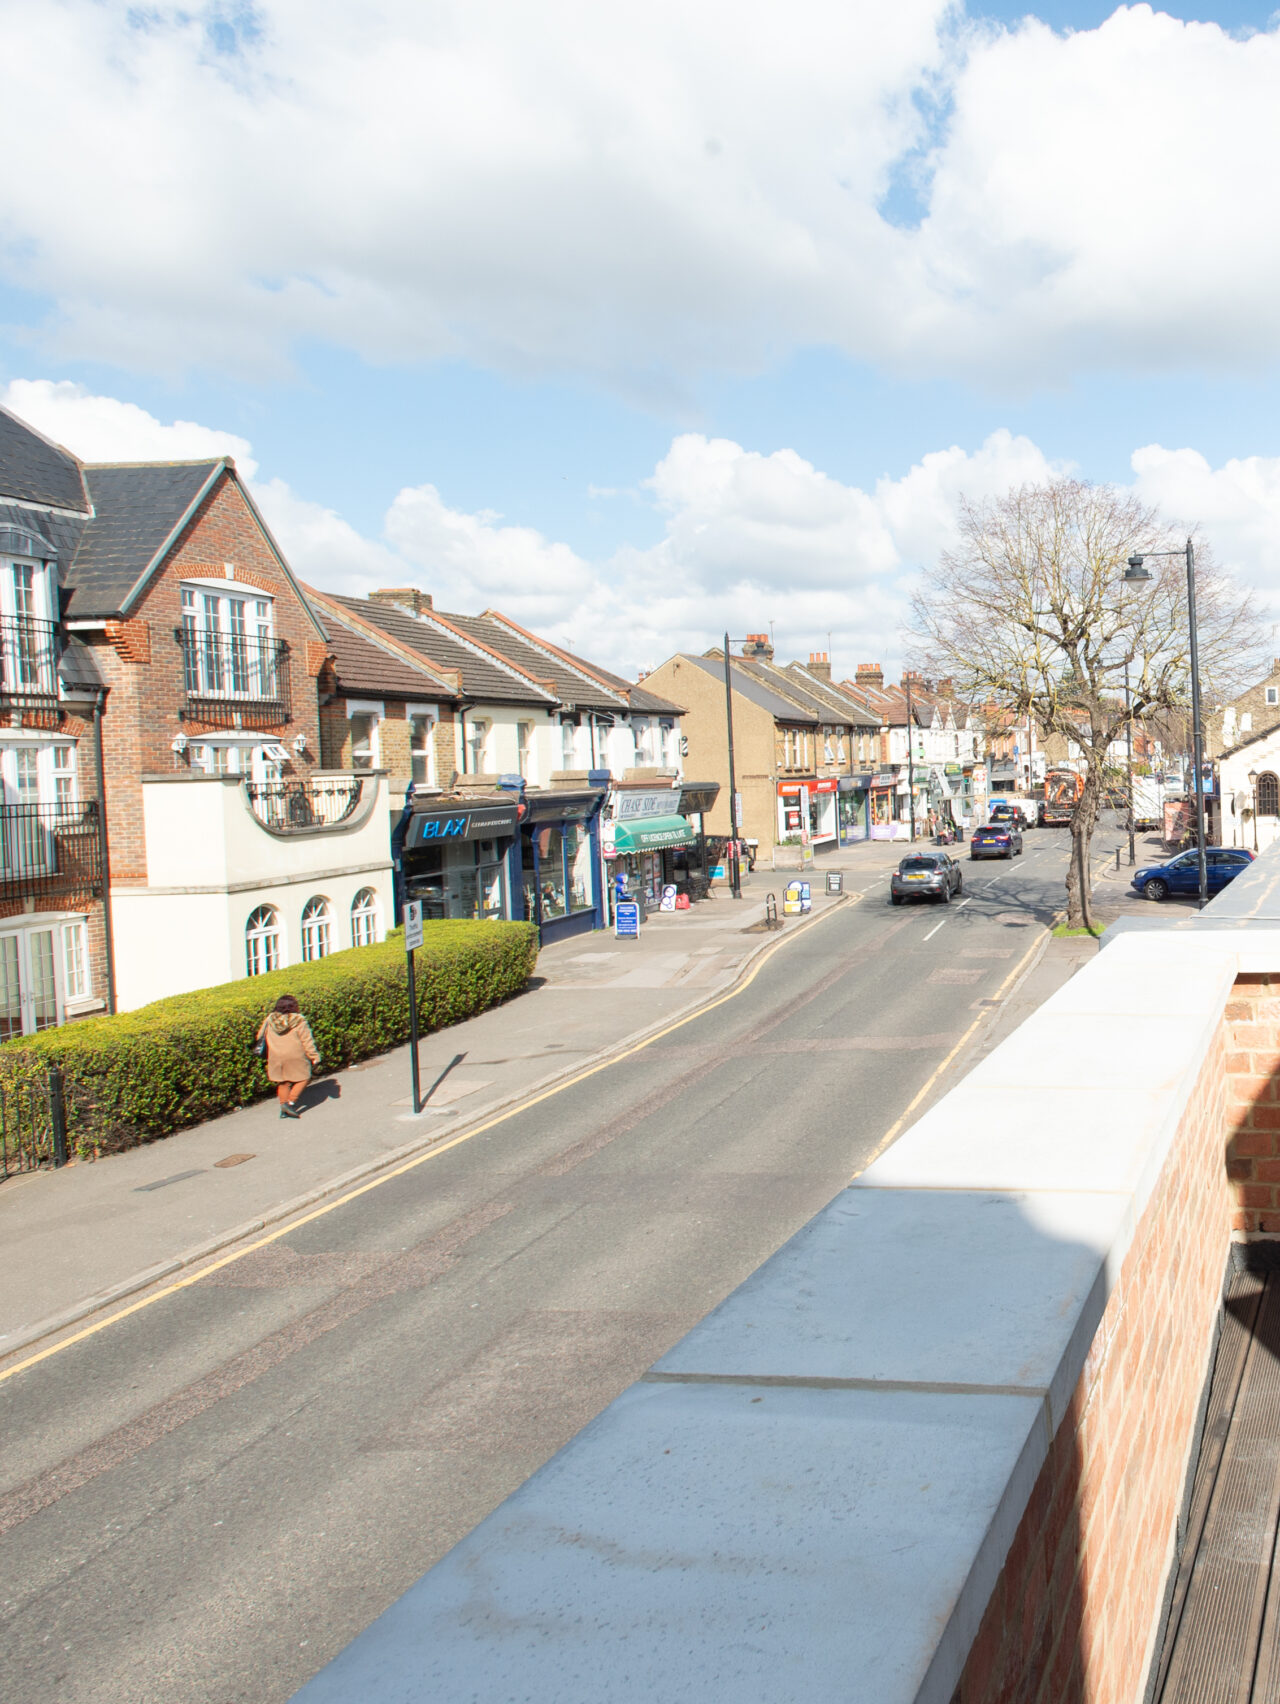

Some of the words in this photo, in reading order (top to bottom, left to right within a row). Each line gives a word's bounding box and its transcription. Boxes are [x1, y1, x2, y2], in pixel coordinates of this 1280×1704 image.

[622, 798, 643, 814] CHASE
[643, 797, 658, 812] SIDE
[422, 818, 466, 839] BLAX
[641, 834, 649, 843] OFF
